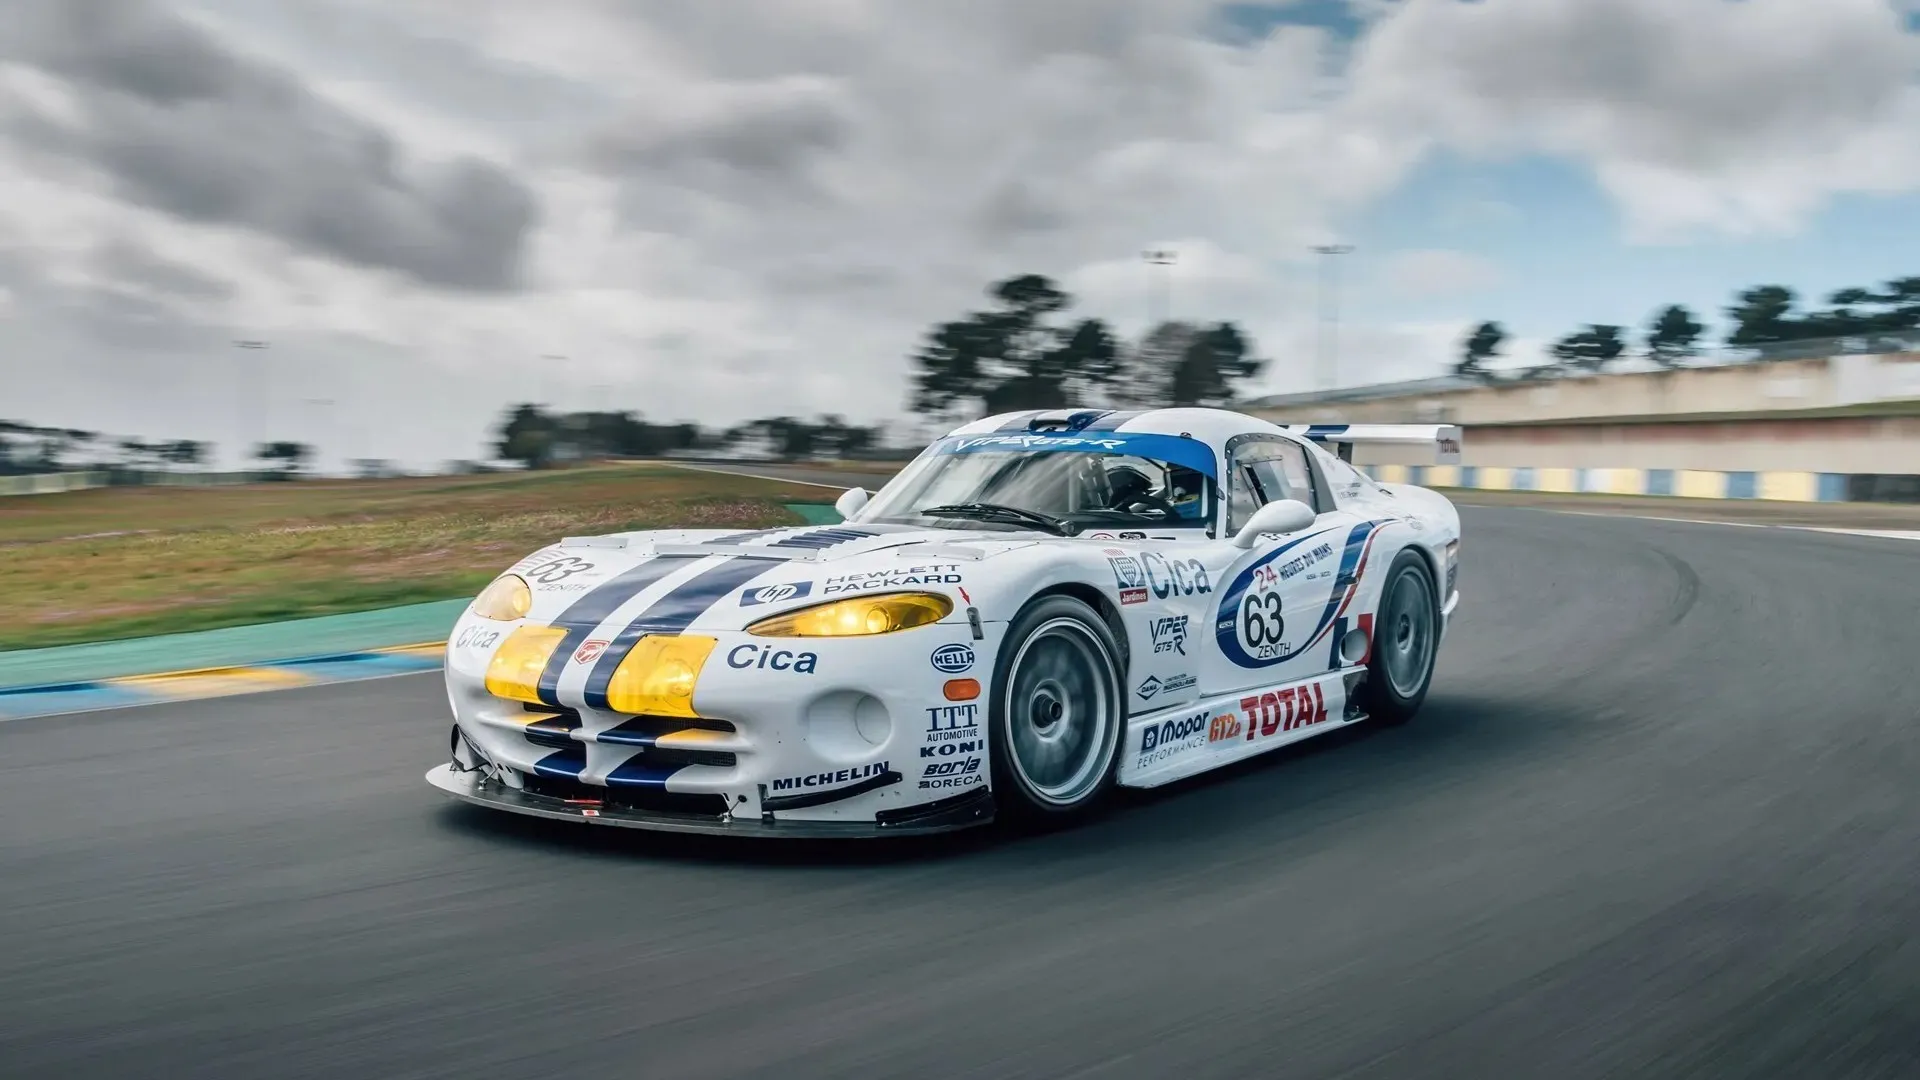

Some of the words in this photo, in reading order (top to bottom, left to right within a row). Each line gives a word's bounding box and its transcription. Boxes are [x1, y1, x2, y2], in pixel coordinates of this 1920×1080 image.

[526, 557, 595, 583] 63
[826, 564, 961, 585] HEWLETT
[1140, 551, 1212, 600] Cica
[1255, 565, 1278, 592] 24
[761, 583, 792, 602] hp
[823, 574, 962, 595] PACKARD
[1149, 614, 1189, 646] VIPER
[1243, 591, 1285, 648] 63
[456, 625, 500, 649] Cica
[1257, 641, 1292, 659] ZENITH
[727, 643, 818, 675] Cica
[934, 650, 975, 665] HELLA
[926, 704, 978, 732] ITT
[1240, 682, 1329, 741] TOTAL
[927, 728, 978, 742] AUTOMOTIVE
[1160, 711, 1210, 746] Mopar
[920, 739, 984, 758] KONI
[1136, 735, 1206, 770] PERFORMANCE
[773, 761, 890, 791] MICHELIN
[924, 756, 982, 776] Borla
